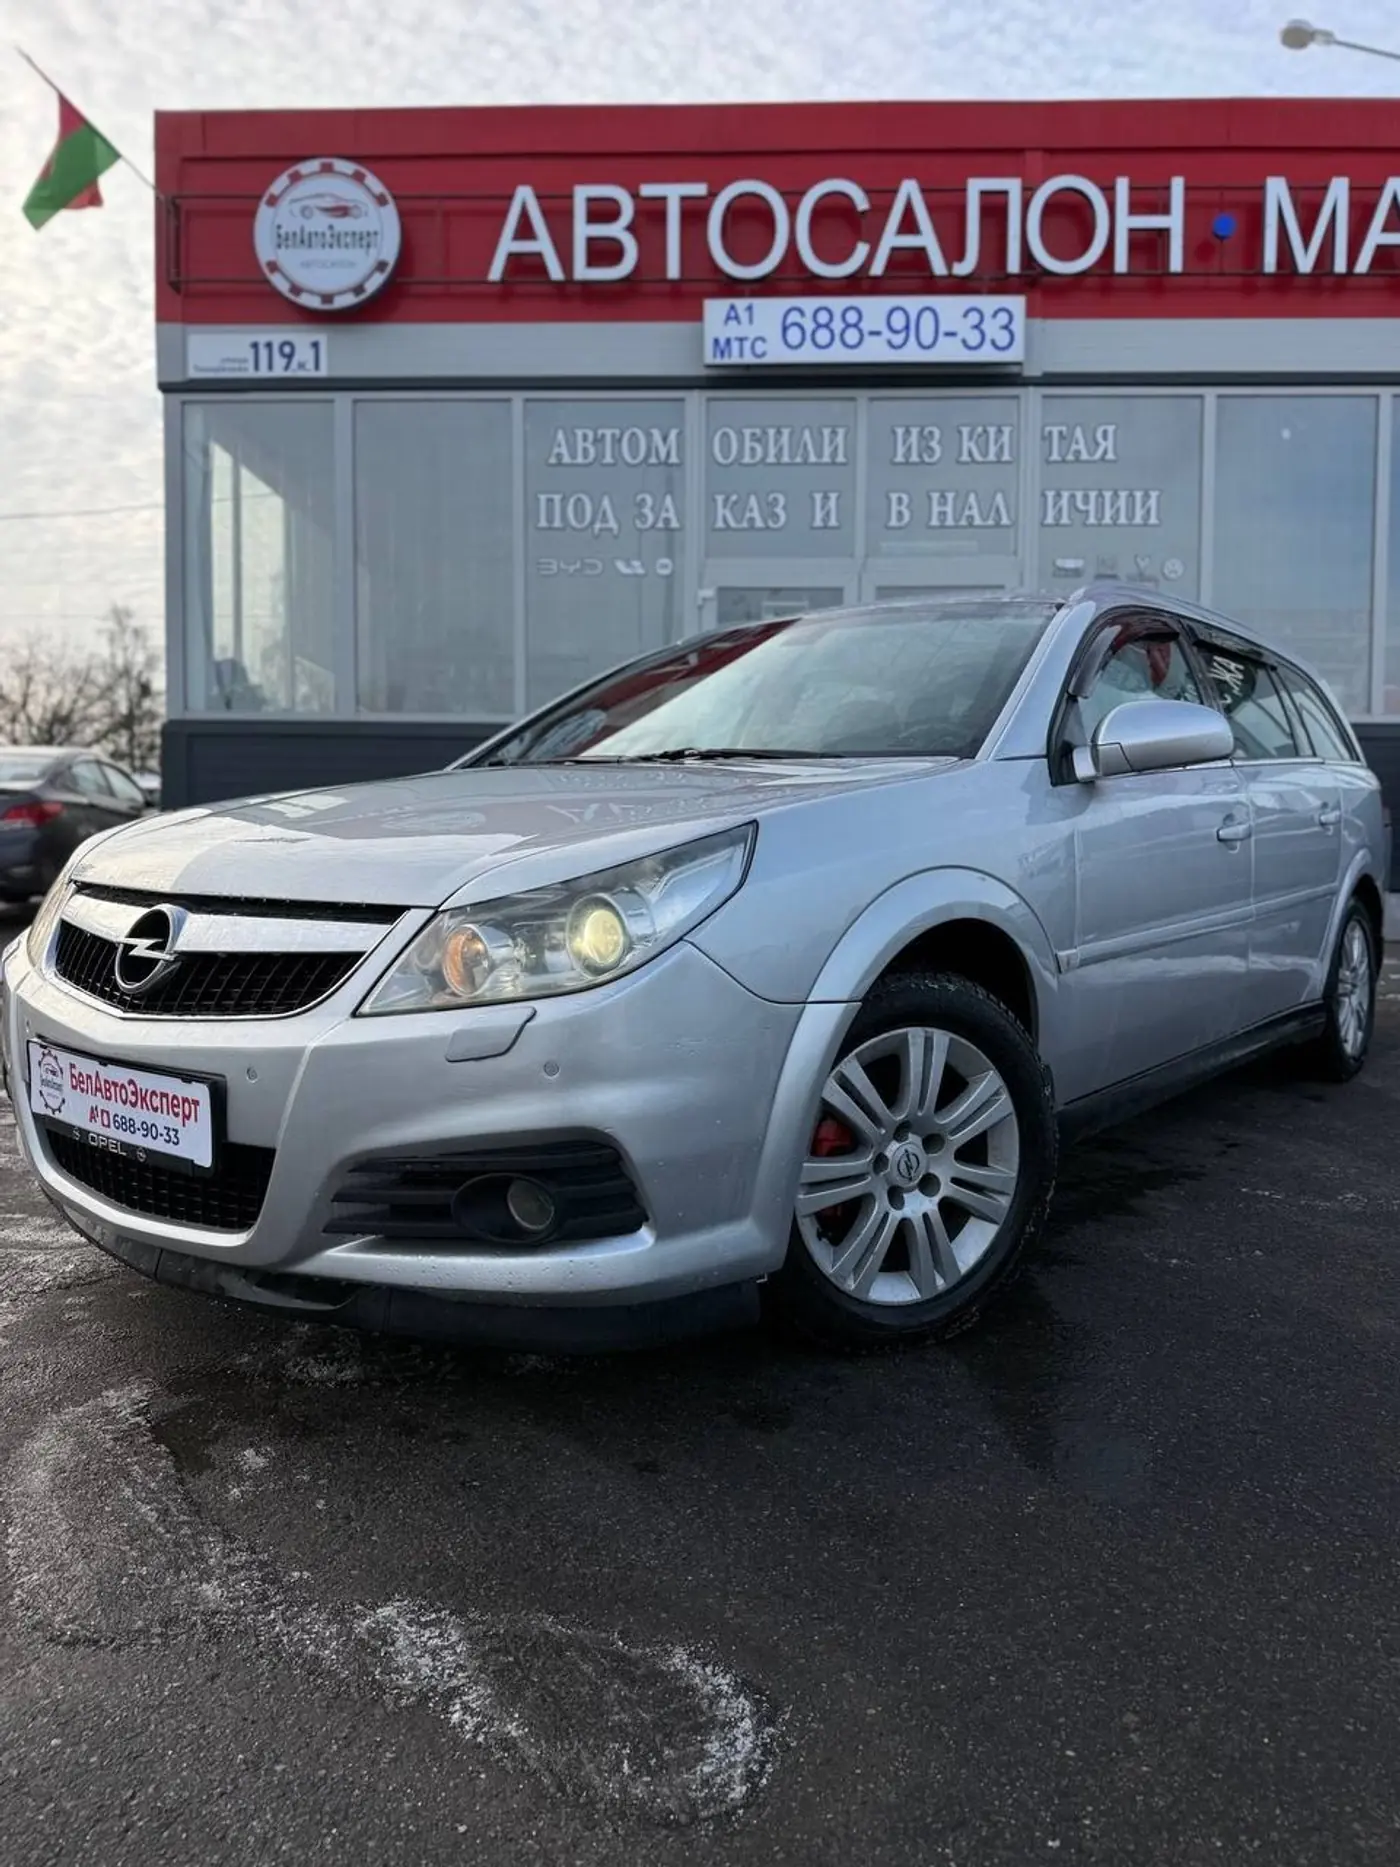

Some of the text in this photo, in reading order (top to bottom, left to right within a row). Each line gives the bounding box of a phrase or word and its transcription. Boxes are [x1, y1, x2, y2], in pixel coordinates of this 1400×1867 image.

[487, 174, 1186, 281] АВТОСАЛОН
[780, 305, 1016, 352] 688-90-33
[893, 426, 942, 463] ИЗ
[536, 493, 619, 536] ПОД
[634, 493, 681, 529] ЗА
[713, 493, 787, 530] КАЗ
[811, 492, 841, 528] И
[888, 492, 911, 527] В
[928, 491, 1014, 527] НАЛ
[68, 1063, 200, 1127] БелАвтоЭксперт
[88, 1135, 128, 1156] OPEL
[112, 1113, 180, 1146] 688-90-33
